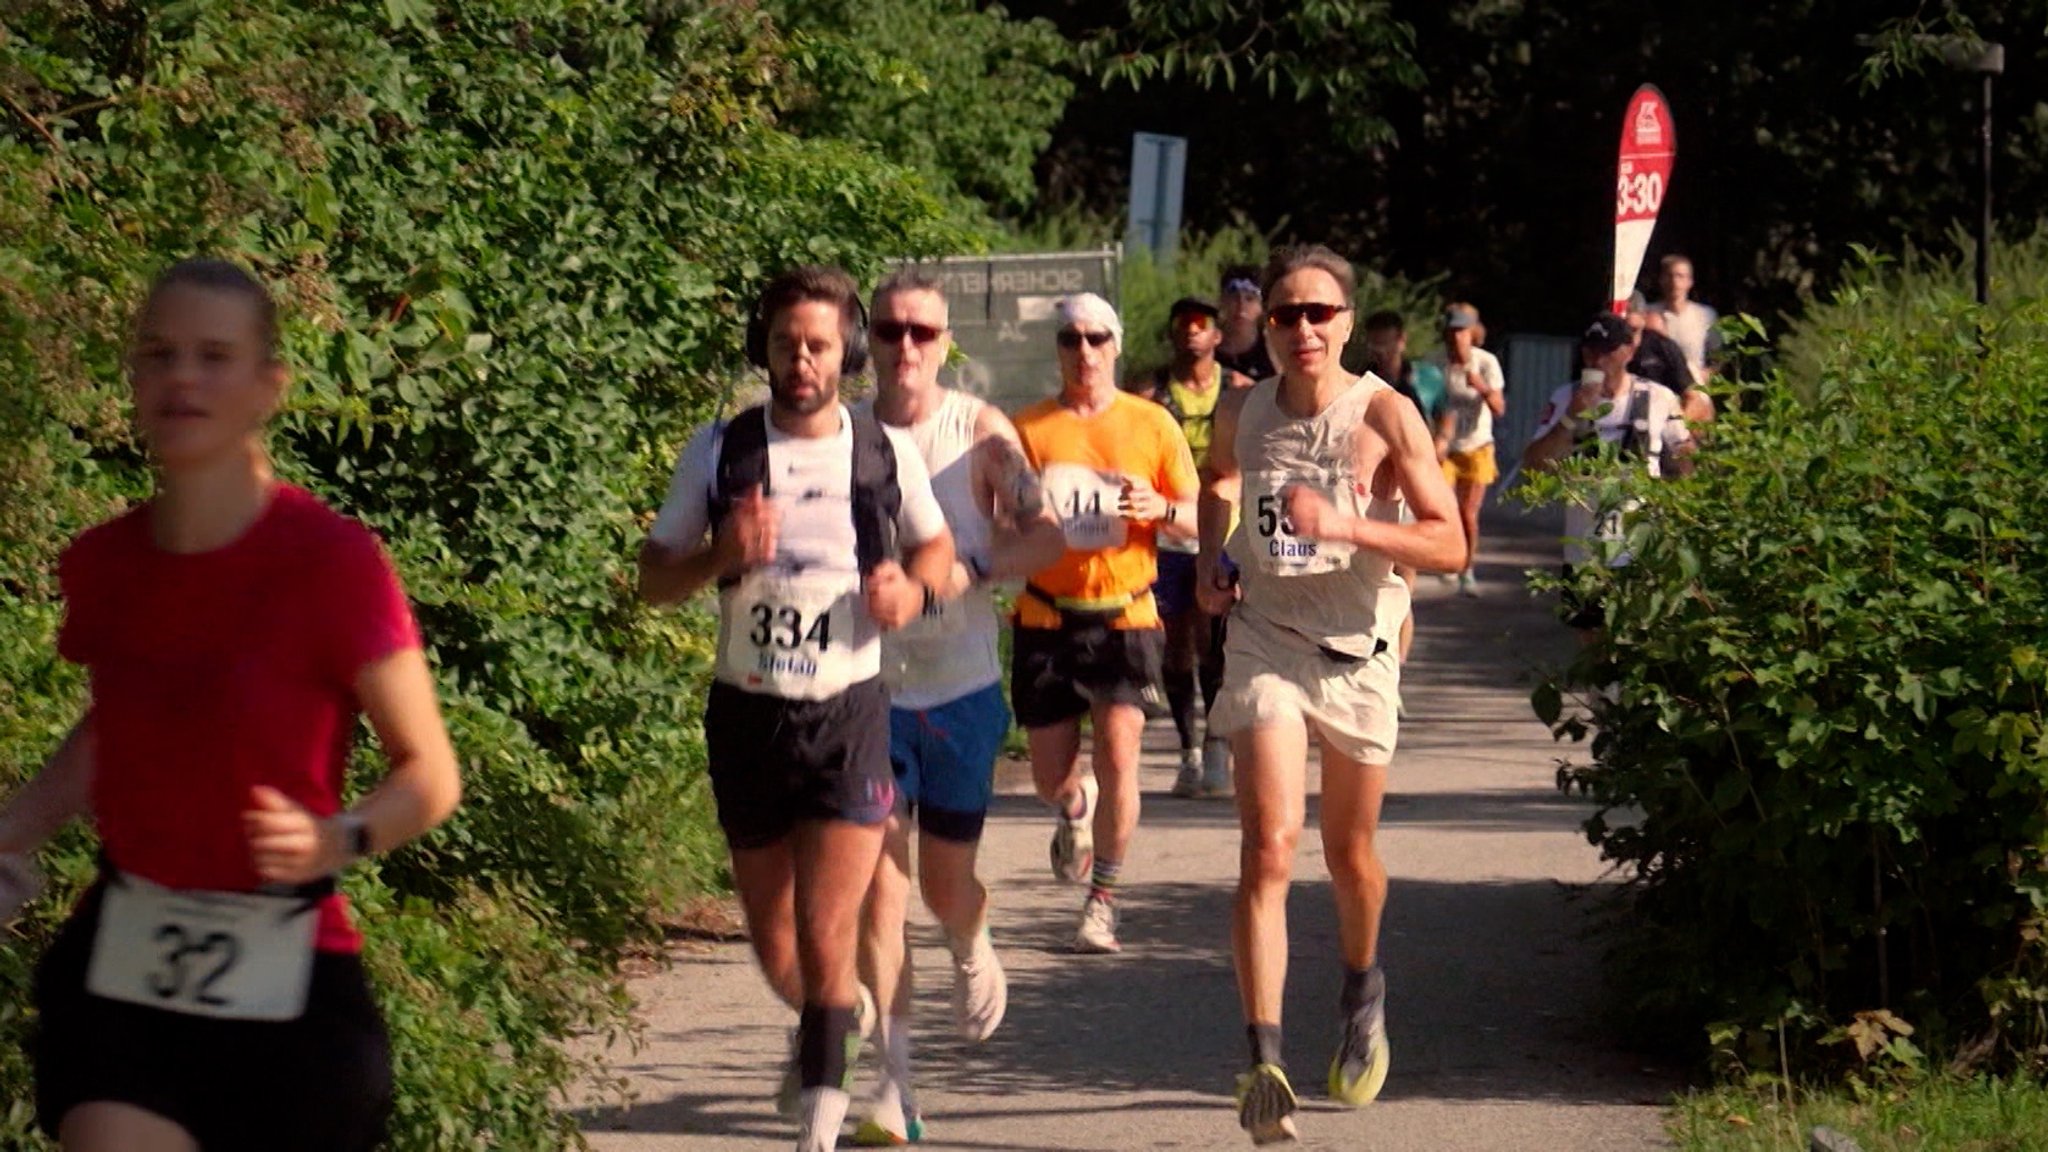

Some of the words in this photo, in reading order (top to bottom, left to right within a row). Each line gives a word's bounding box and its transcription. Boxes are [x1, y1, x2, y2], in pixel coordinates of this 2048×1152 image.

[1269, 539, 1317, 557] Claus
[750, 603, 832, 652] 334
[146, 921, 242, 1006] 32
